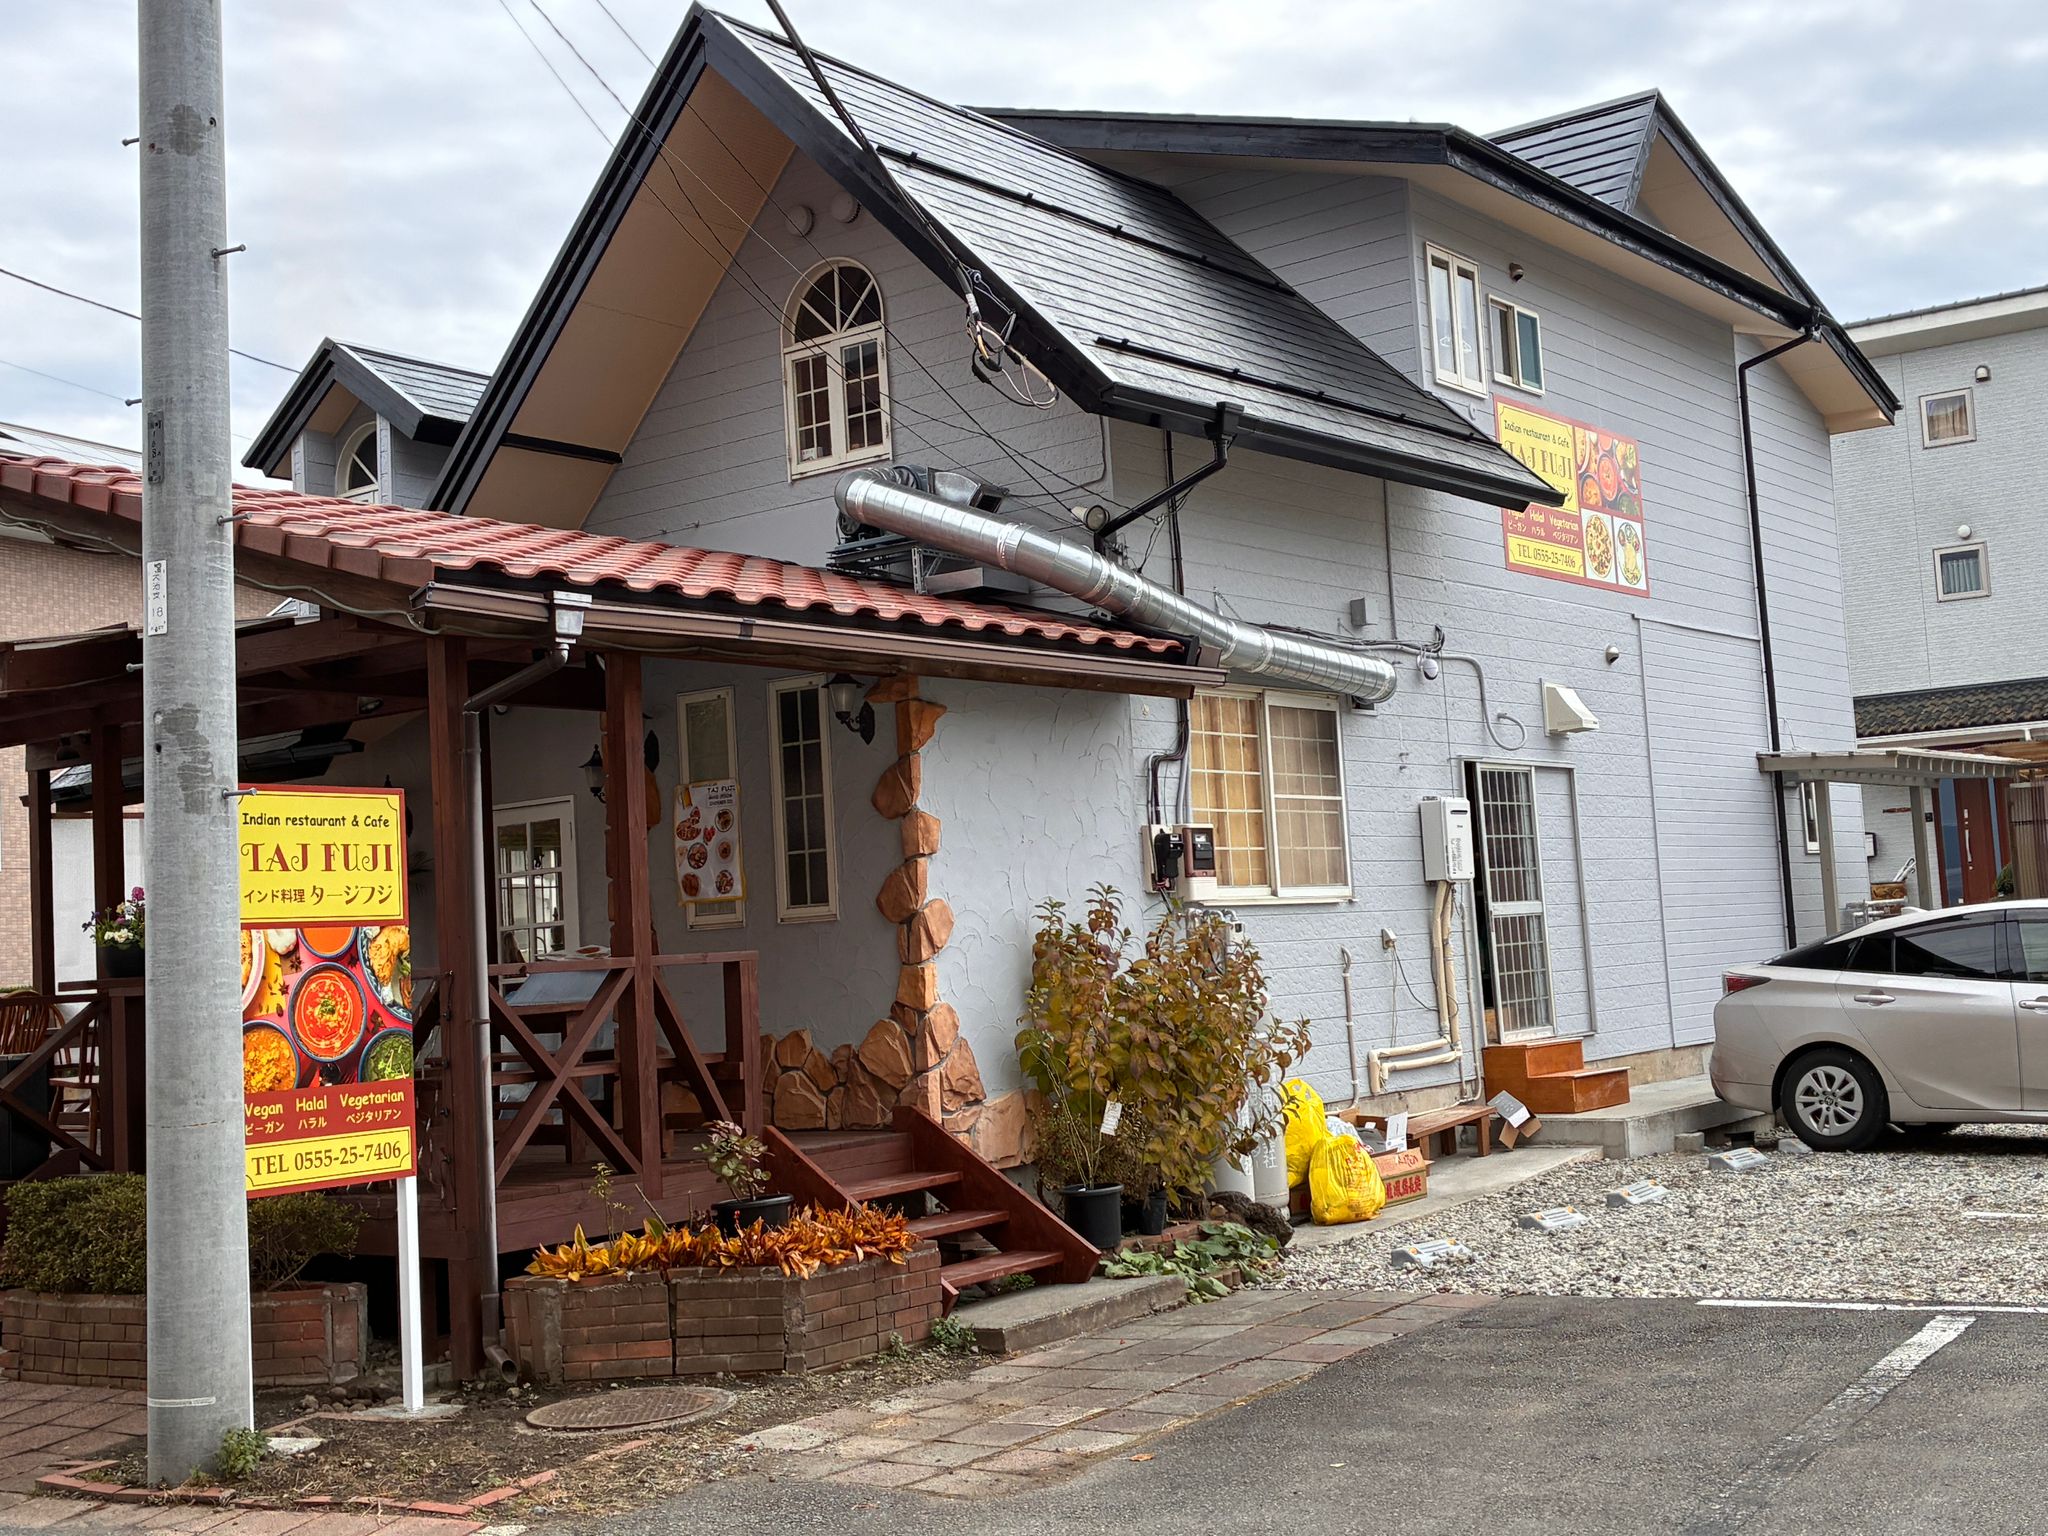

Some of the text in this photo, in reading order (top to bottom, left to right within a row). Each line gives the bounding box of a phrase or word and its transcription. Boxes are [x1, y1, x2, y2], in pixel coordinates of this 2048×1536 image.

[1504, 419, 1570, 448] Indian restaurant & Cafe
[1504, 440, 1573, 480] TAJ FUJI
[1529, 509, 1545, 523] Halal
[1549, 513, 1579, 531] Vegetarian
[1516, 543, 1576, 569] TEL 0555-25-7406
[242, 812, 390, 828] Indian restaurant & Cafe
[240, 842, 393, 872] TAJ FUJI
[244, 885, 393, 906] インド料理 タージフジ
[244, 1089, 405, 1120] Vegan Halal Vegetarian
[298, 1116, 328, 1130] ハラル
[346, 1109, 402, 1124] ベジタリアン
[251, 1140, 402, 1176] TEL 0555-25-7406
